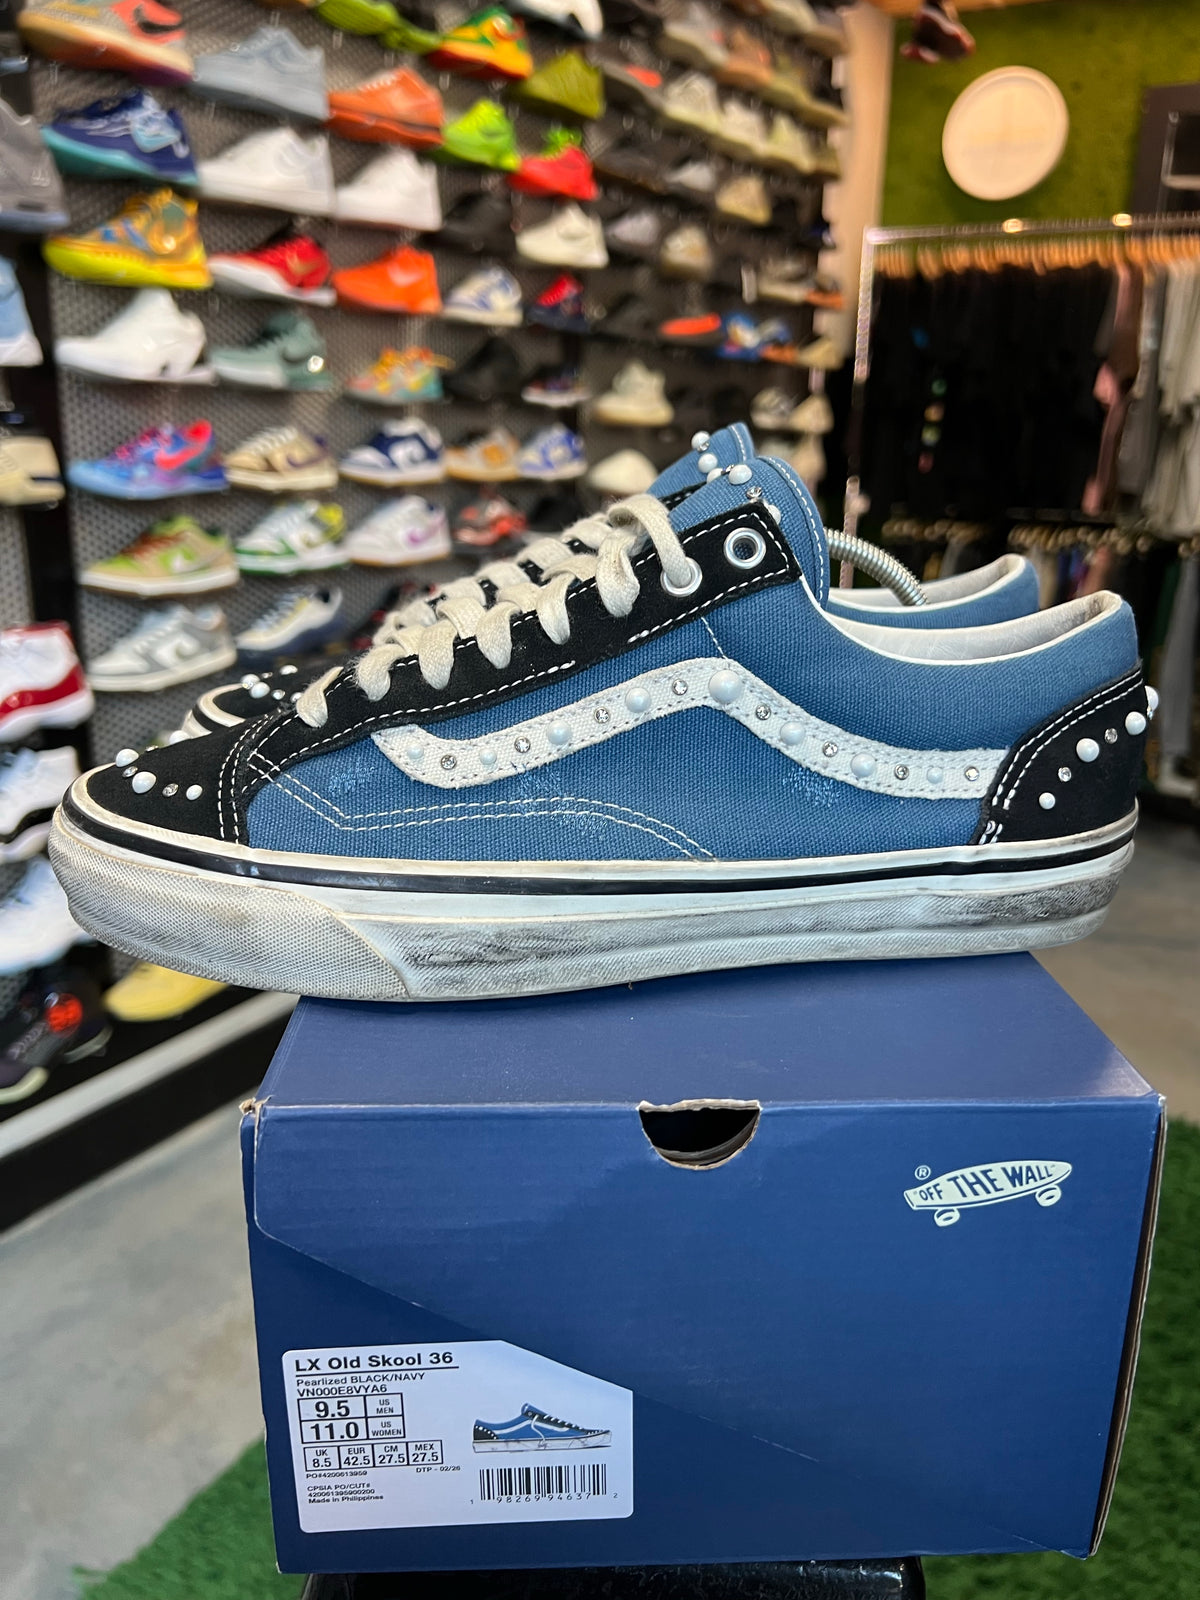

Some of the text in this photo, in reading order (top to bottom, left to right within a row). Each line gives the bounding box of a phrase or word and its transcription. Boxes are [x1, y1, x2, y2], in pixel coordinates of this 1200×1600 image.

[947, 1169, 1004, 1198] THE
[1001, 1165, 1053, 1188] WALL
[295, 1352, 453, 1372] LX Old Skool 36
[296, 1372, 426, 1387] Pearlized BLACK/NAVY
[297, 1384, 388, 1397] VN000E8VYA6
[315, 1400, 350, 1418] 9.5
[376, 1407, 394, 1415] MEN
[310, 1422, 359, 1440] 11.0
[371, 1429, 402, 1437] WOMEN
[348, 1447, 365, 1455] EUR
[384, 1445, 398, 1453] CM
[415, 1443, 434, 1451] MEX
[312, 1452, 439, 1468] 8.5 42.5 27.5 27.5
[341, 1495, 384, 1503] Philippines
